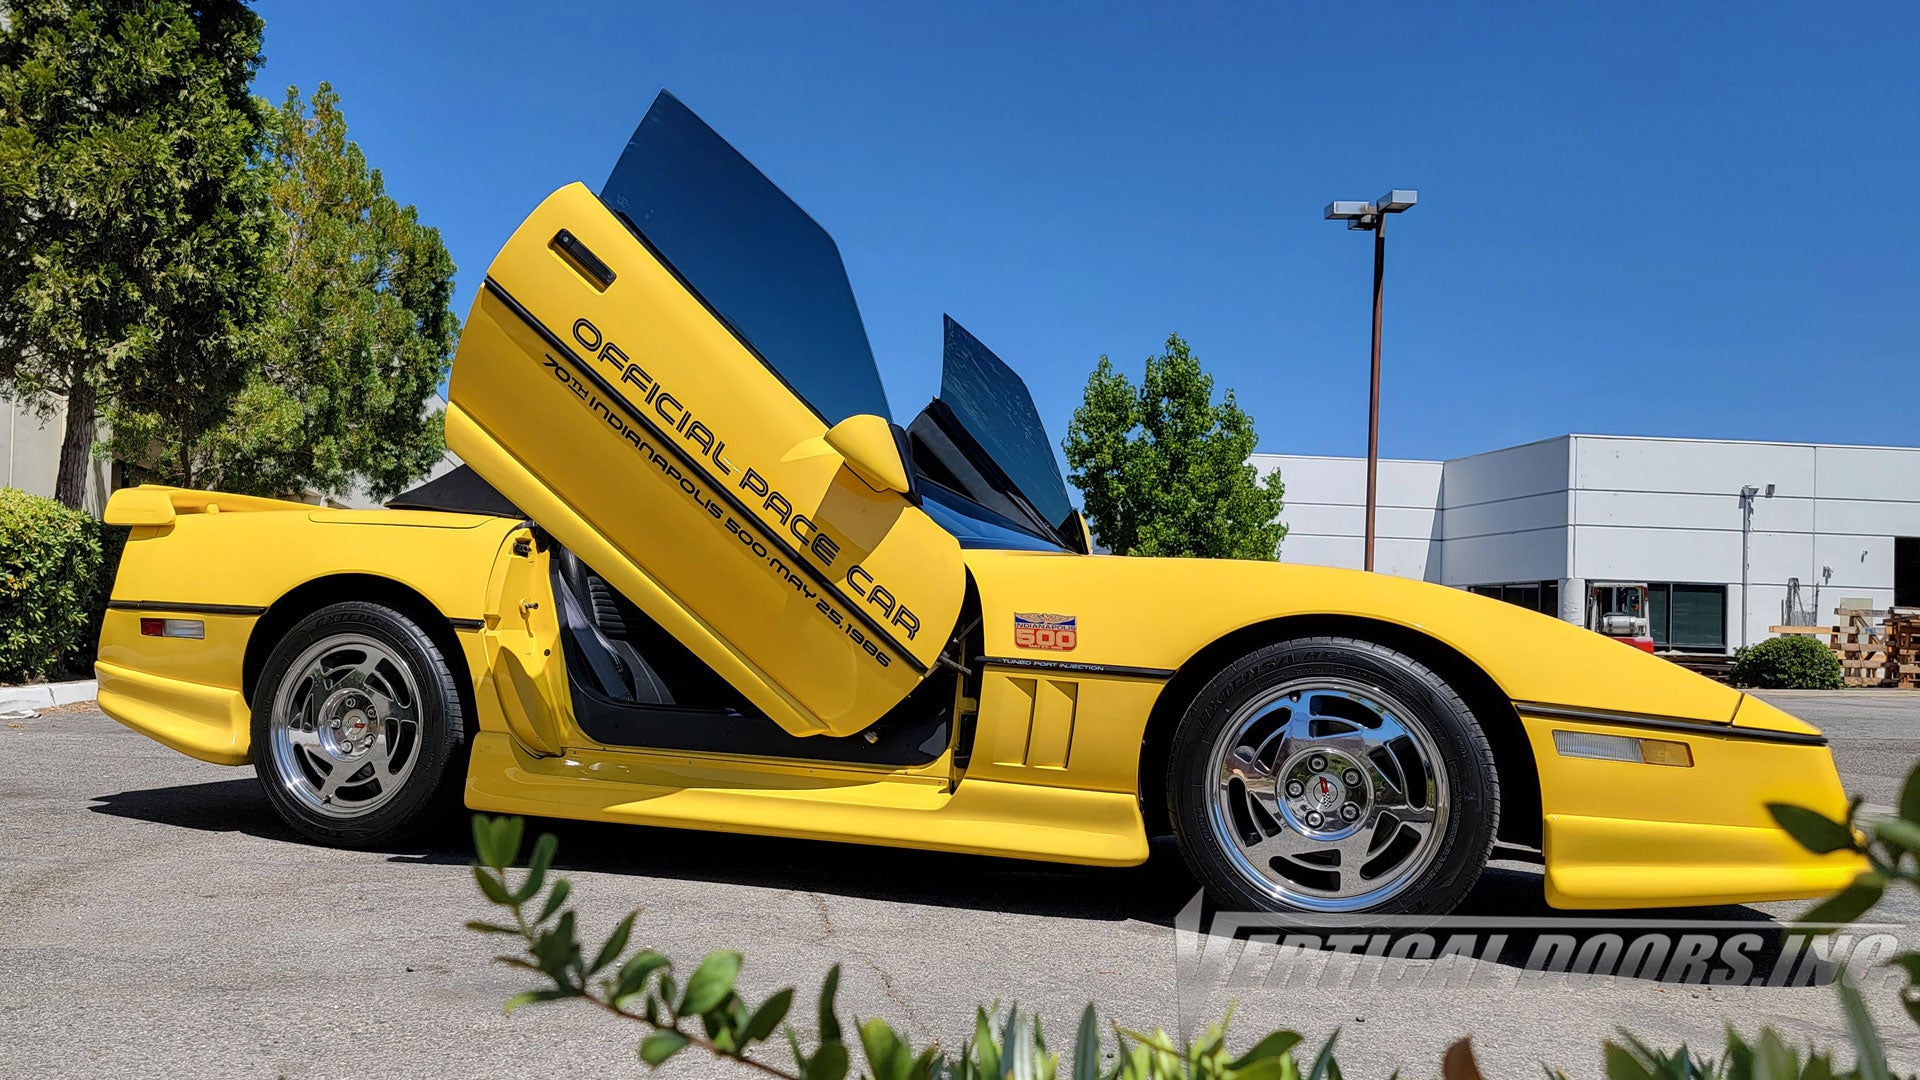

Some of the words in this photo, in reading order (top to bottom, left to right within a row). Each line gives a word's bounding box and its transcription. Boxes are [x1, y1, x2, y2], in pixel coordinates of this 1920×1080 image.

[589, 396, 724, 519] INDIANAPOLIS
[572, 317, 731, 476] OFFICIAL
[739, 467, 841, 567] PACE
[846, 564, 921, 641] CAR
[1014, 622, 1076, 631] INDIANAPOLIS
[1016, 628, 1076, 648] 500
[1002, 658, 1032, 666] TUNED
